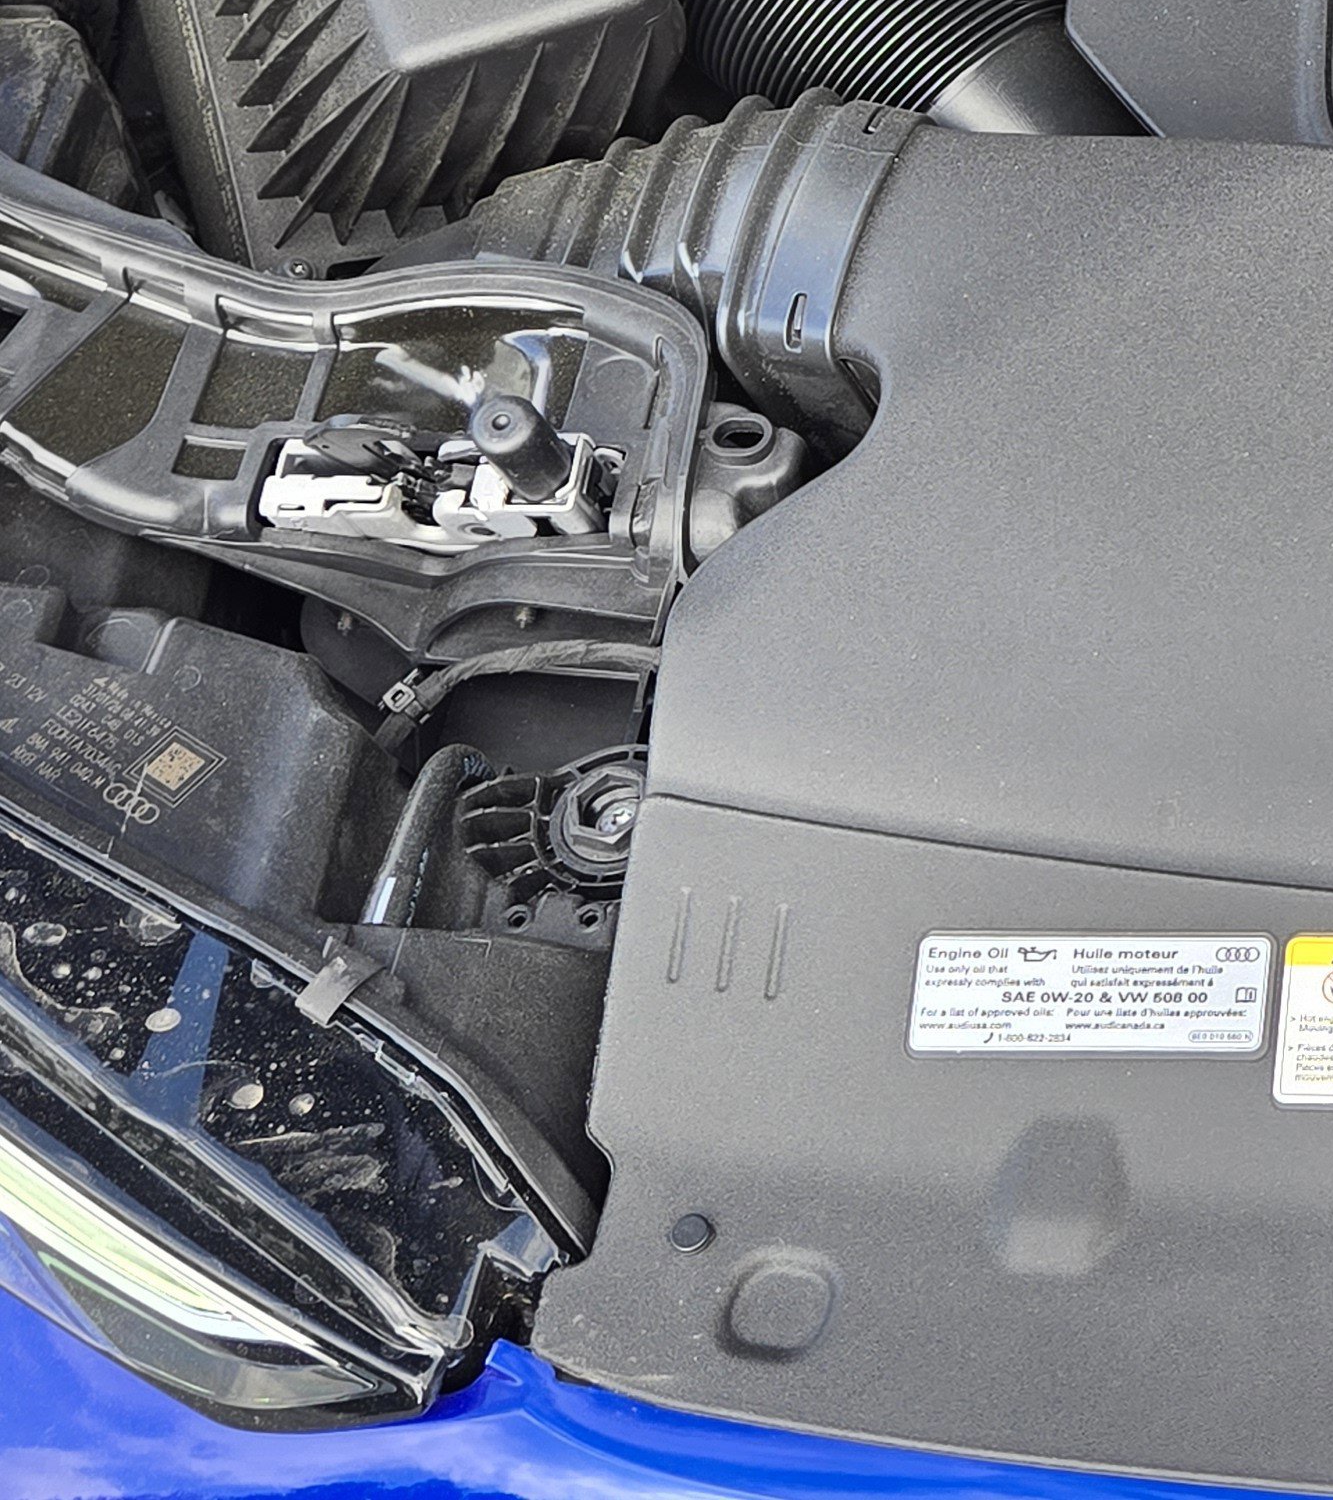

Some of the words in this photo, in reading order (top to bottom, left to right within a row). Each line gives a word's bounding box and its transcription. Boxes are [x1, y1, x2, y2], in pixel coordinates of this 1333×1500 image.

[928, 947, 982, 960] Engine
[988, 947, 1009, 959] Oil
[1073, 948, 1113, 959] Huile
[1118, 949, 1178, 959] moteur
[926, 965, 945, 974] Use
[948, 966, 970, 976] only
[973, 965, 986, 973] oil
[988, 965, 1008, 974] that
[1071, 965, 1109, 975] Utilisez
[1111, 966, 1174, 976] uniquement
[1177, 966, 1189, 974] de
[925, 979, 973, 988] expressly
[975, 978, 1020, 987] complies
[1023, 978, 1045, 986] with
[1070, 978, 1087, 988] qui
[1090, 978, 1130, 987] satisfait
[1001, 991, 1035, 1003] SAE
[1040, 991, 1094, 1003] 0W-20
[1099, 992, 1112, 1004] &
[1118, 992, 1149, 1003] VW
[1153, 992, 1183, 1004] 508
[1188, 992, 1208, 1004] 00
[920, 1007, 938, 1016] For
[949, 1008, 964, 1016] list
[968, 1007, 978, 1016] of
[981, 1008, 1030, 1018] approved
[1066, 1008, 1091, 1017] Pour
[1094, 1009, 1113, 1017] une
[1116, 1009, 1137, 1017] liste
[919, 1021, 1012, 1029] www.audiusa.com
[1065, 1021, 1165, 1030] www.audicanada.ca
